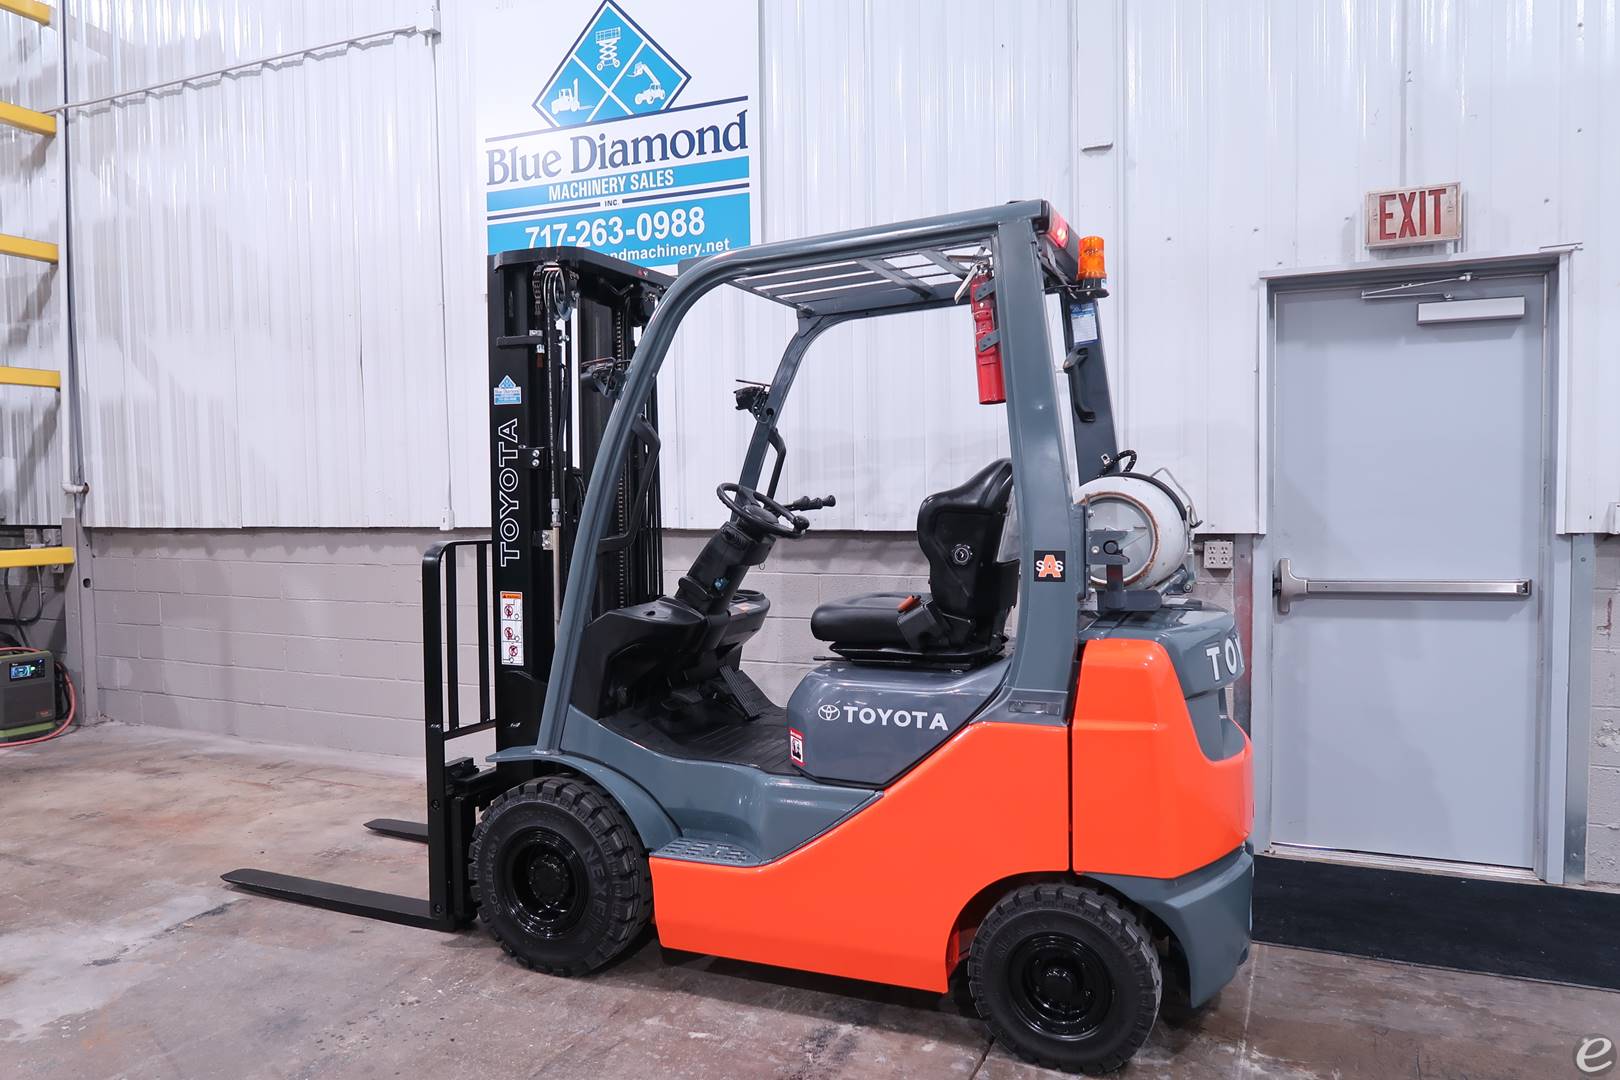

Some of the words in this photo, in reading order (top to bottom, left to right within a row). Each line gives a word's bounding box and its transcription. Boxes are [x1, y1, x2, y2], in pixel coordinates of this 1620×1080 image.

[486, 145, 562, 186] Blue
[570, 109, 749, 174] Diamond
[548, 175, 626, 201] MACHINERY
[630, 169, 674, 190] SALES
[604, 199, 620, 207] INC.
[525, 206, 705, 250] 717-263-0988
[1379, 188, 1447, 240] EXIT
[604, 238, 730, 261] ndmachinery.net
[498, 417, 520, 568] TOYOTA
[1035, 554, 1064, 578] SAS
[1205, 636, 1244, 681] TO
[843, 705, 949, 731] TOYOTA
